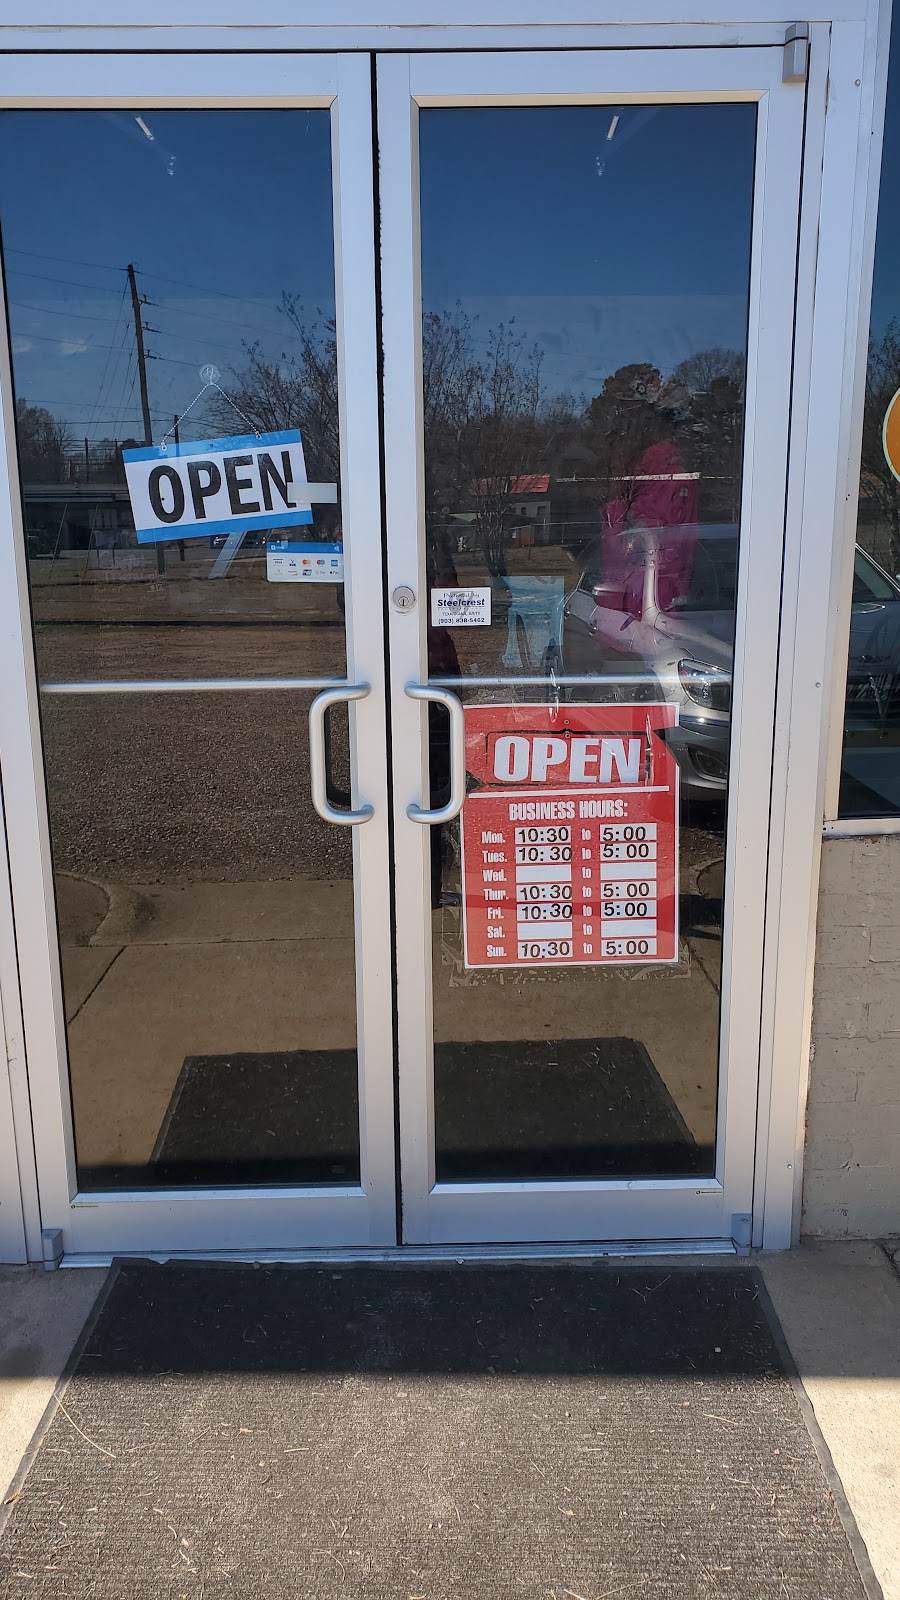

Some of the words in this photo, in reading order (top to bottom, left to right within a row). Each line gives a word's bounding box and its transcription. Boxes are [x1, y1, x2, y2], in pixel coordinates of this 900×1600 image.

[148, 450, 297, 524] OPEN
[494, 736, 641, 784] OPEN
[509, 802, 575, 821] BUSINESS
[579, 799, 628, 818] HOURS:
[482, 831, 506, 844] Mon.
[518, 827, 569, 842] 10:30
[581, 828, 592, 840] to
[603, 826, 646, 841] 5:00
[482, 850, 508, 863] Tues.
[518, 847, 572, 861] 10:30
[581, 848, 592, 860] to
[603, 843, 649, 858] 5:00
[483, 869, 508, 882] Wed.
[581, 867, 592, 879] to
[484, 888, 509, 901] Thur.
[520, 885, 572, 901] 10:30
[582, 886, 592, 898] to
[603, 882, 650, 898] 5:00
[487, 906, 504, 920] Fri.
[521, 904, 572, 920] 10:30
[582, 904, 593, 917] to
[604, 902, 648, 917] 5:00
[487, 925, 506, 938] Sat.
[582, 923, 593, 936] to
[486, 944, 507, 957] Sun.
[521, 942, 570, 958] 10:30
[583, 942, 593, 955] to
[605, 940, 649, 956] 5:00
